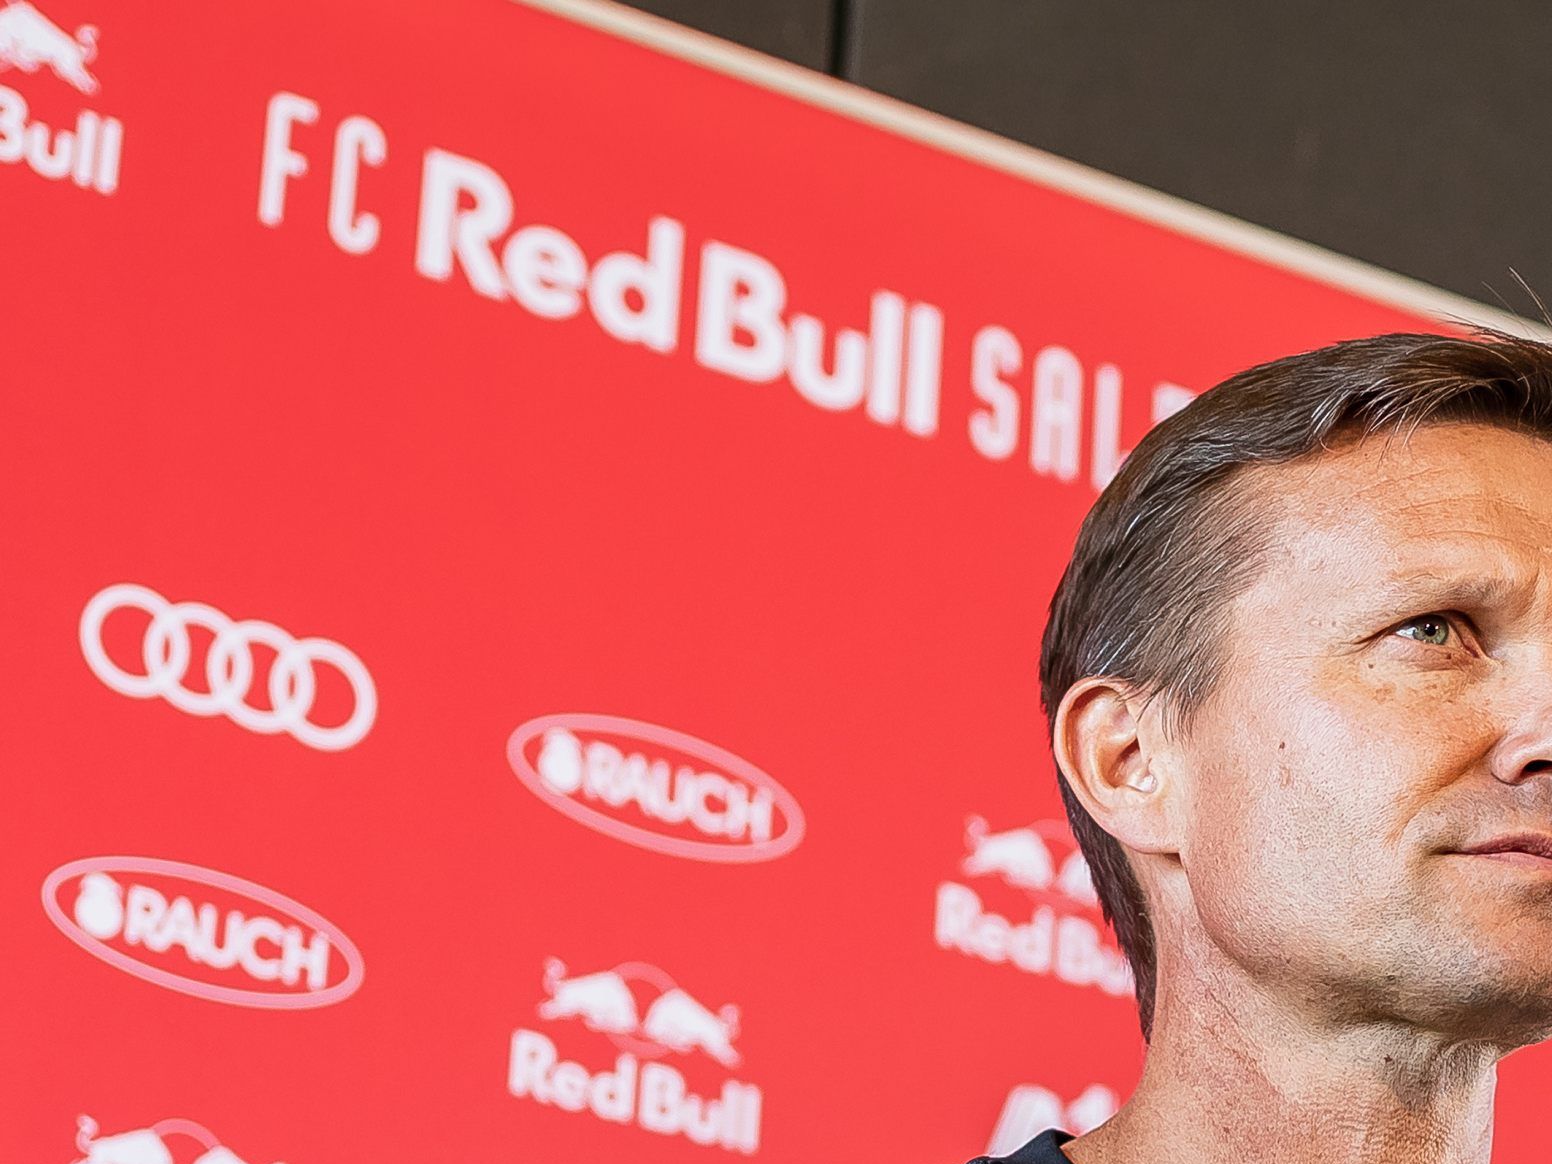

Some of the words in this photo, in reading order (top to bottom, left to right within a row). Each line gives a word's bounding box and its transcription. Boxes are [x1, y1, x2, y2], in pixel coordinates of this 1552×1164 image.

[256, 90, 388, 256] FC
[415, 147, 687, 355] Red
[694, 238, 945, 438] Bull
[584, 742, 774, 846] RAUCH
[123, 884, 331, 991] RAUCH
[935, 879, 1054, 976] Red
[507, 1028, 637, 1122] Red
[638, 1061, 763, 1157] Bull
